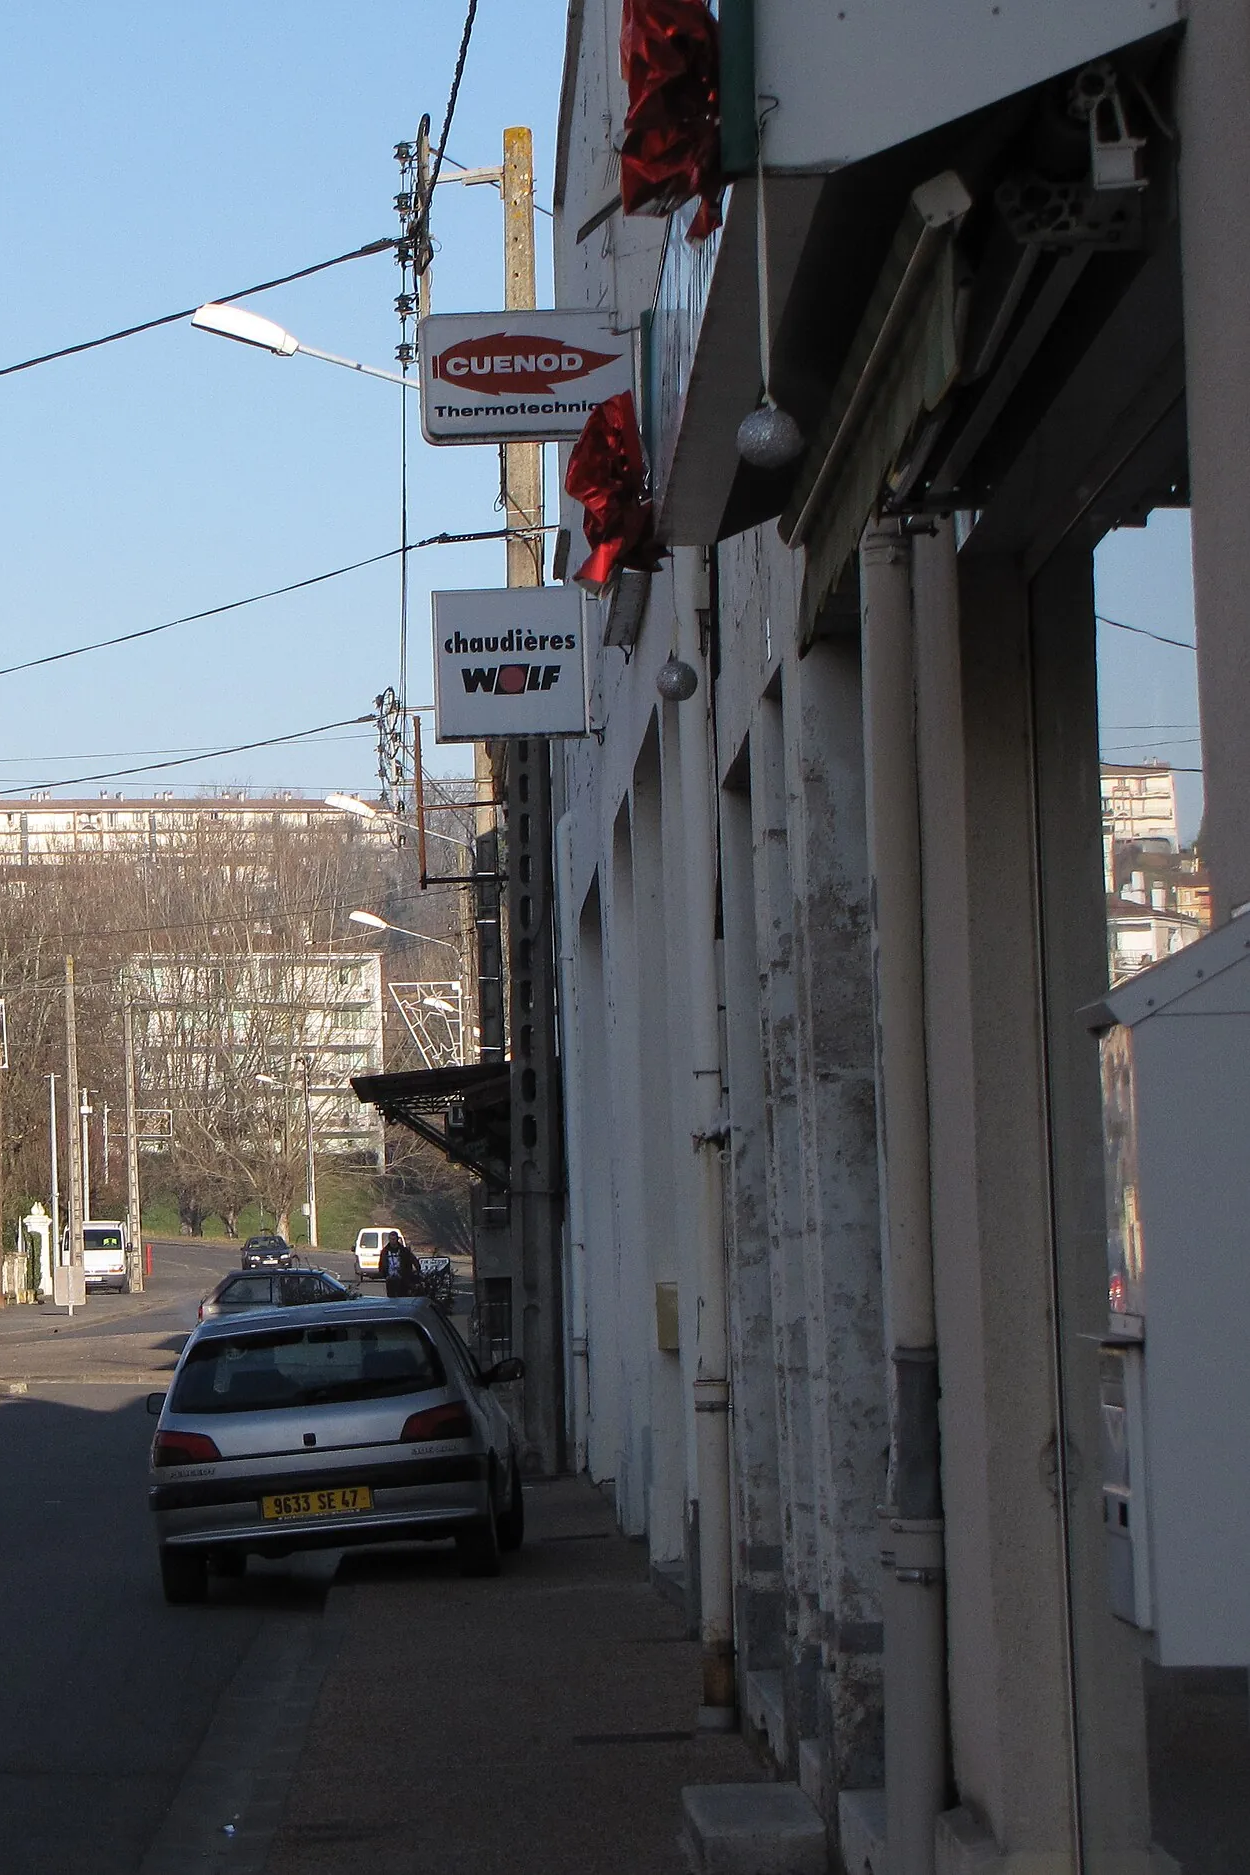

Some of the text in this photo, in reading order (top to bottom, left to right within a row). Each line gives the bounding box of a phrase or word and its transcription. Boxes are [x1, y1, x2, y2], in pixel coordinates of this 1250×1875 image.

[445, 352, 584, 377] CUENOD
[444, 629, 576, 654] chaudières
[461, 664, 561, 695] WOLF
[273, 1495, 311, 1515] 9633
[317, 1492, 336, 1510] SE
[341, 1490, 358, 1507] 47
